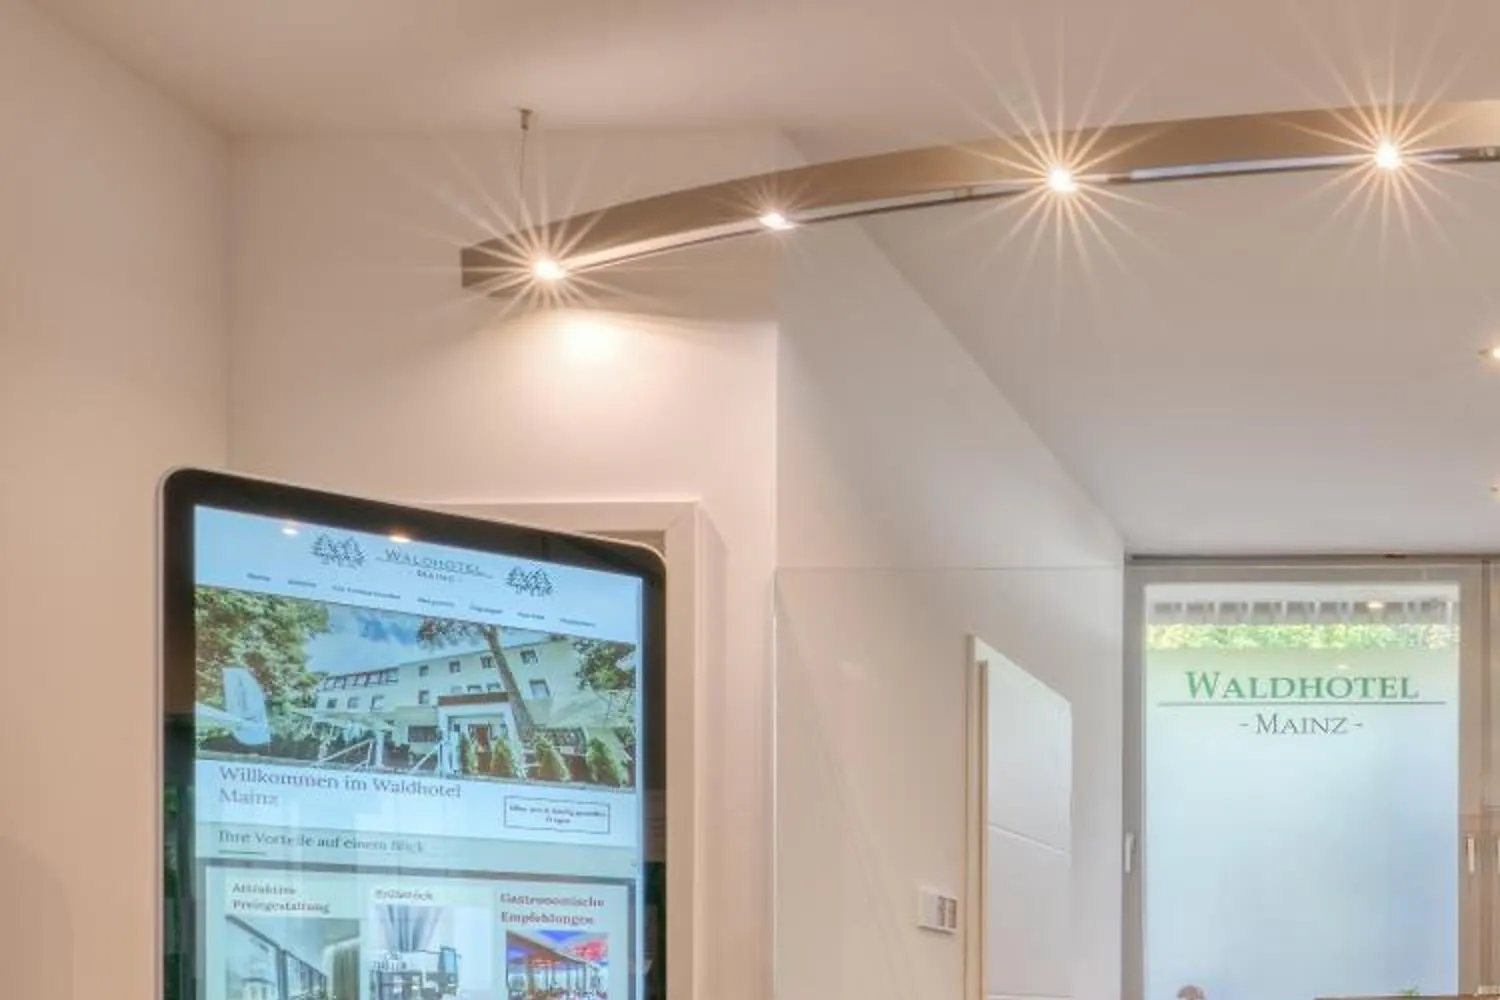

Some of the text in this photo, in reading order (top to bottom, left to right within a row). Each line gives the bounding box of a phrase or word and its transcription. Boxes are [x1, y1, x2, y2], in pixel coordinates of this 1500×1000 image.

[1185, 671, 1420, 699] WALDHOTEL
[219, 765, 462, 798] Willkommen im Waldhotel
[253, 831, 315, 847] Vortele
[317, 832, 340, 848] auf
